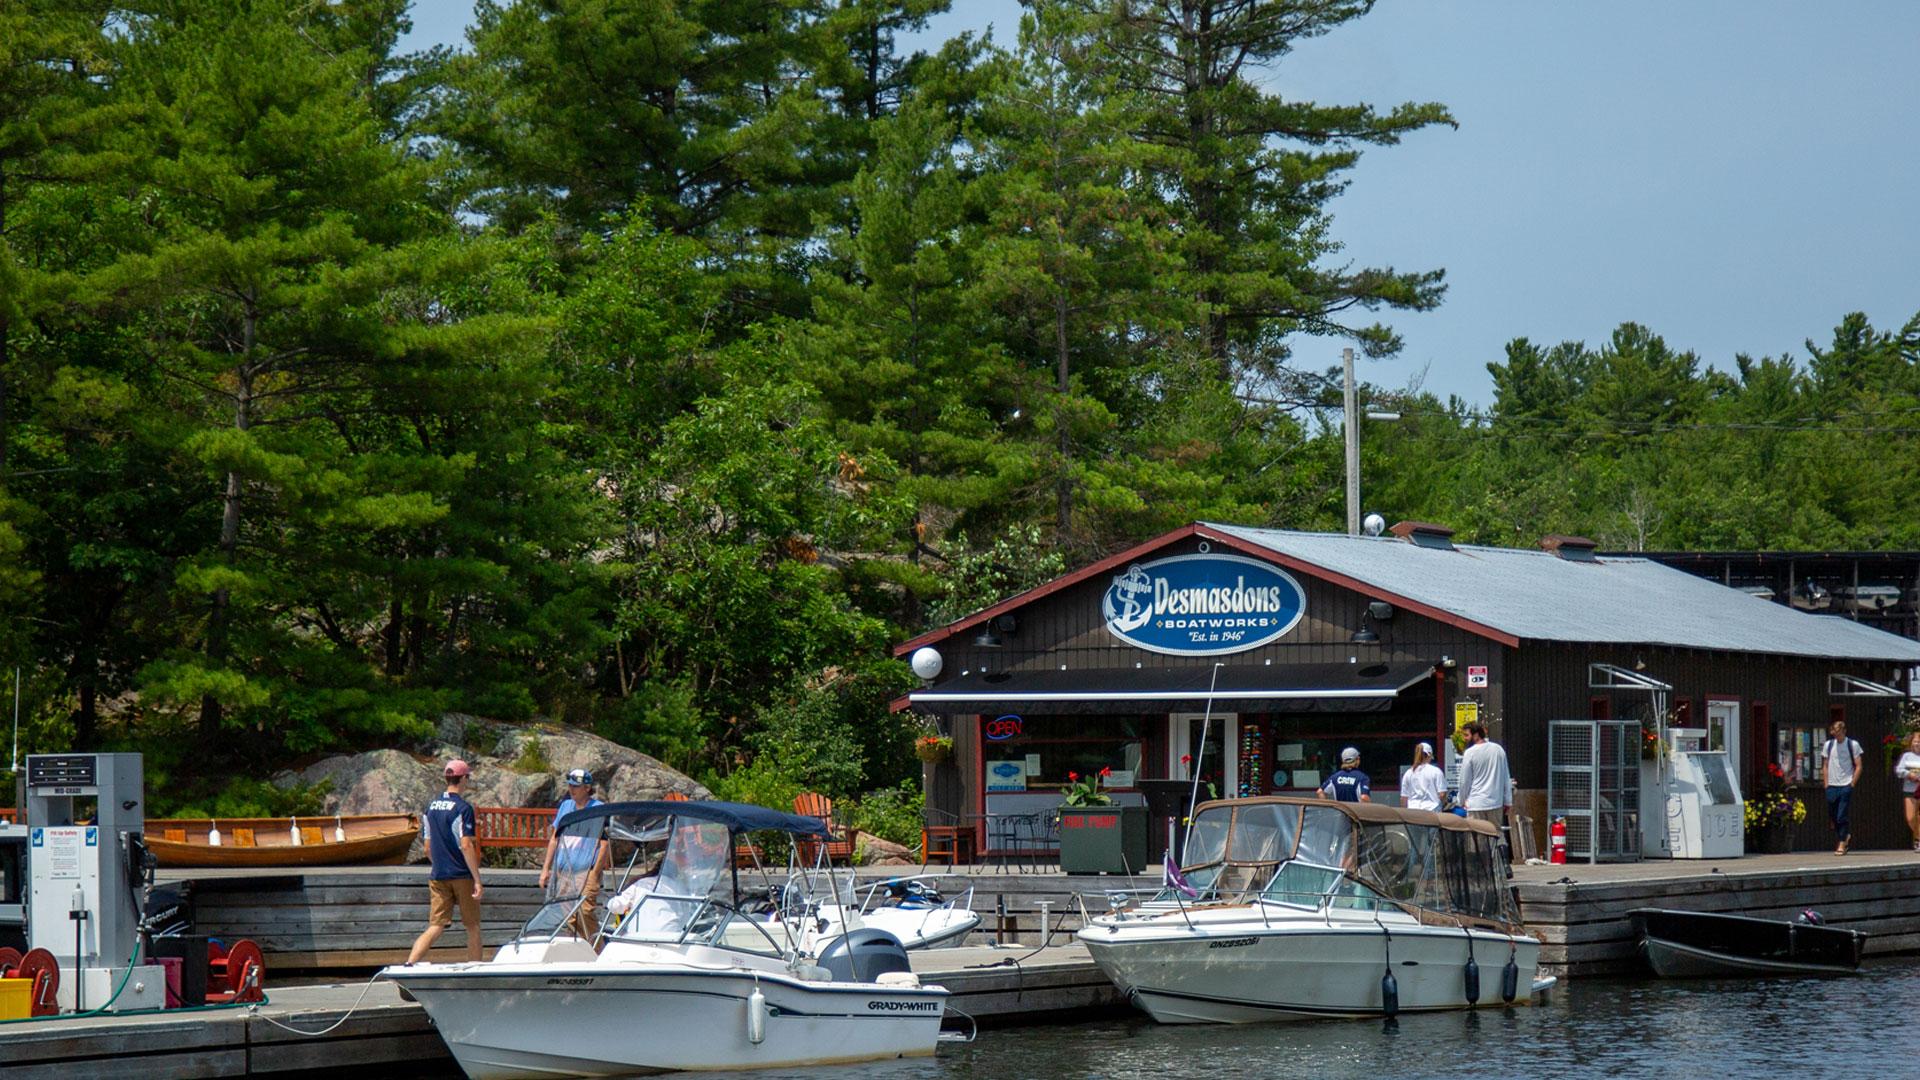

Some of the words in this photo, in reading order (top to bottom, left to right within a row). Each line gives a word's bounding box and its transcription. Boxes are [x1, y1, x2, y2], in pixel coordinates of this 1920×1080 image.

[1155, 576, 1280, 615] Desmasdons
[1165, 618, 1268, 628] BOATWORKS
[1210, 631, 1218, 641] in
[986, 721, 1022, 735] OPEN
[1337, 776, 1356, 785] CREW
[430, 800, 456, 811] CREW
[867, 1001, 938, 1011] GRADY-WHITE
